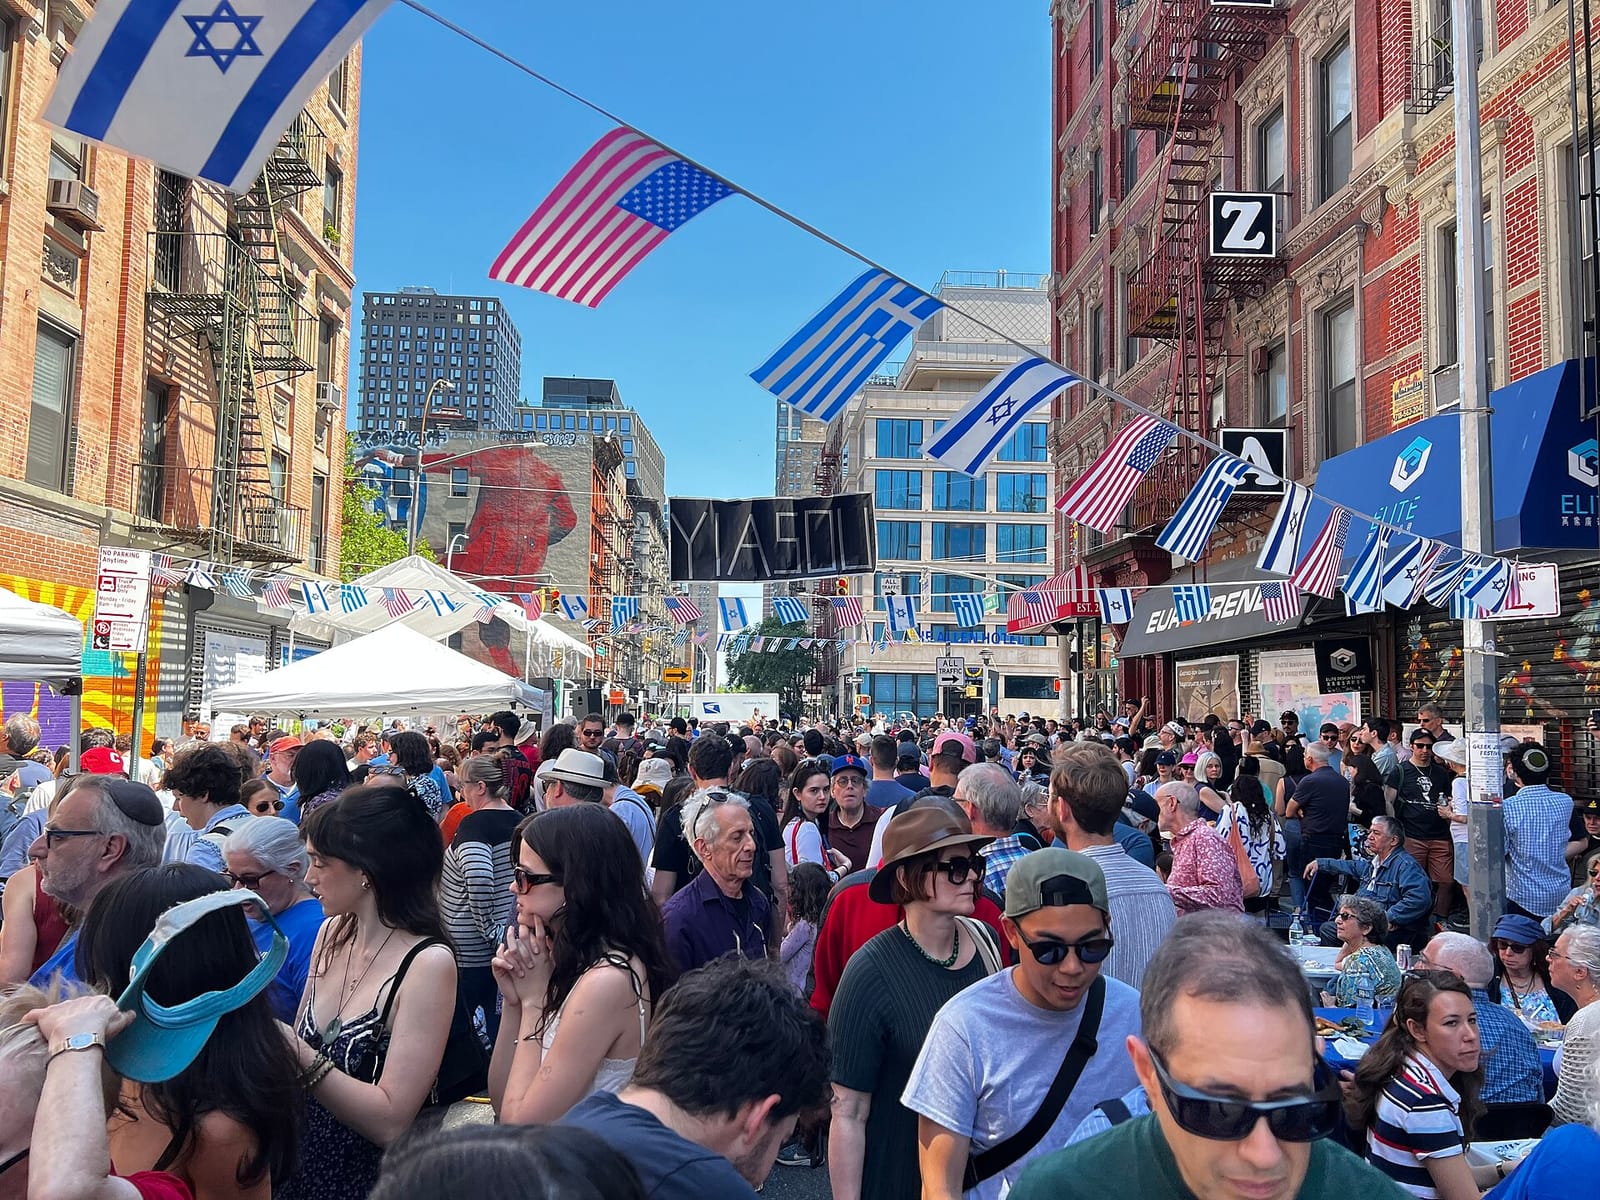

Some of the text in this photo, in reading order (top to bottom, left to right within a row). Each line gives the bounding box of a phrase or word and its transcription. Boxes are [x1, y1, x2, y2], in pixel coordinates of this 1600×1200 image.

[1221, 200, 1265, 250] Z
[1236, 436, 1280, 486] A
[1561, 494, 1600, 514] ELI
[102, 556, 129, 564] Anytime
[113, 550, 140, 559] PARKING
[1518, 571, 1536, 582] ING
[1077, 603, 1093, 613] EST.
